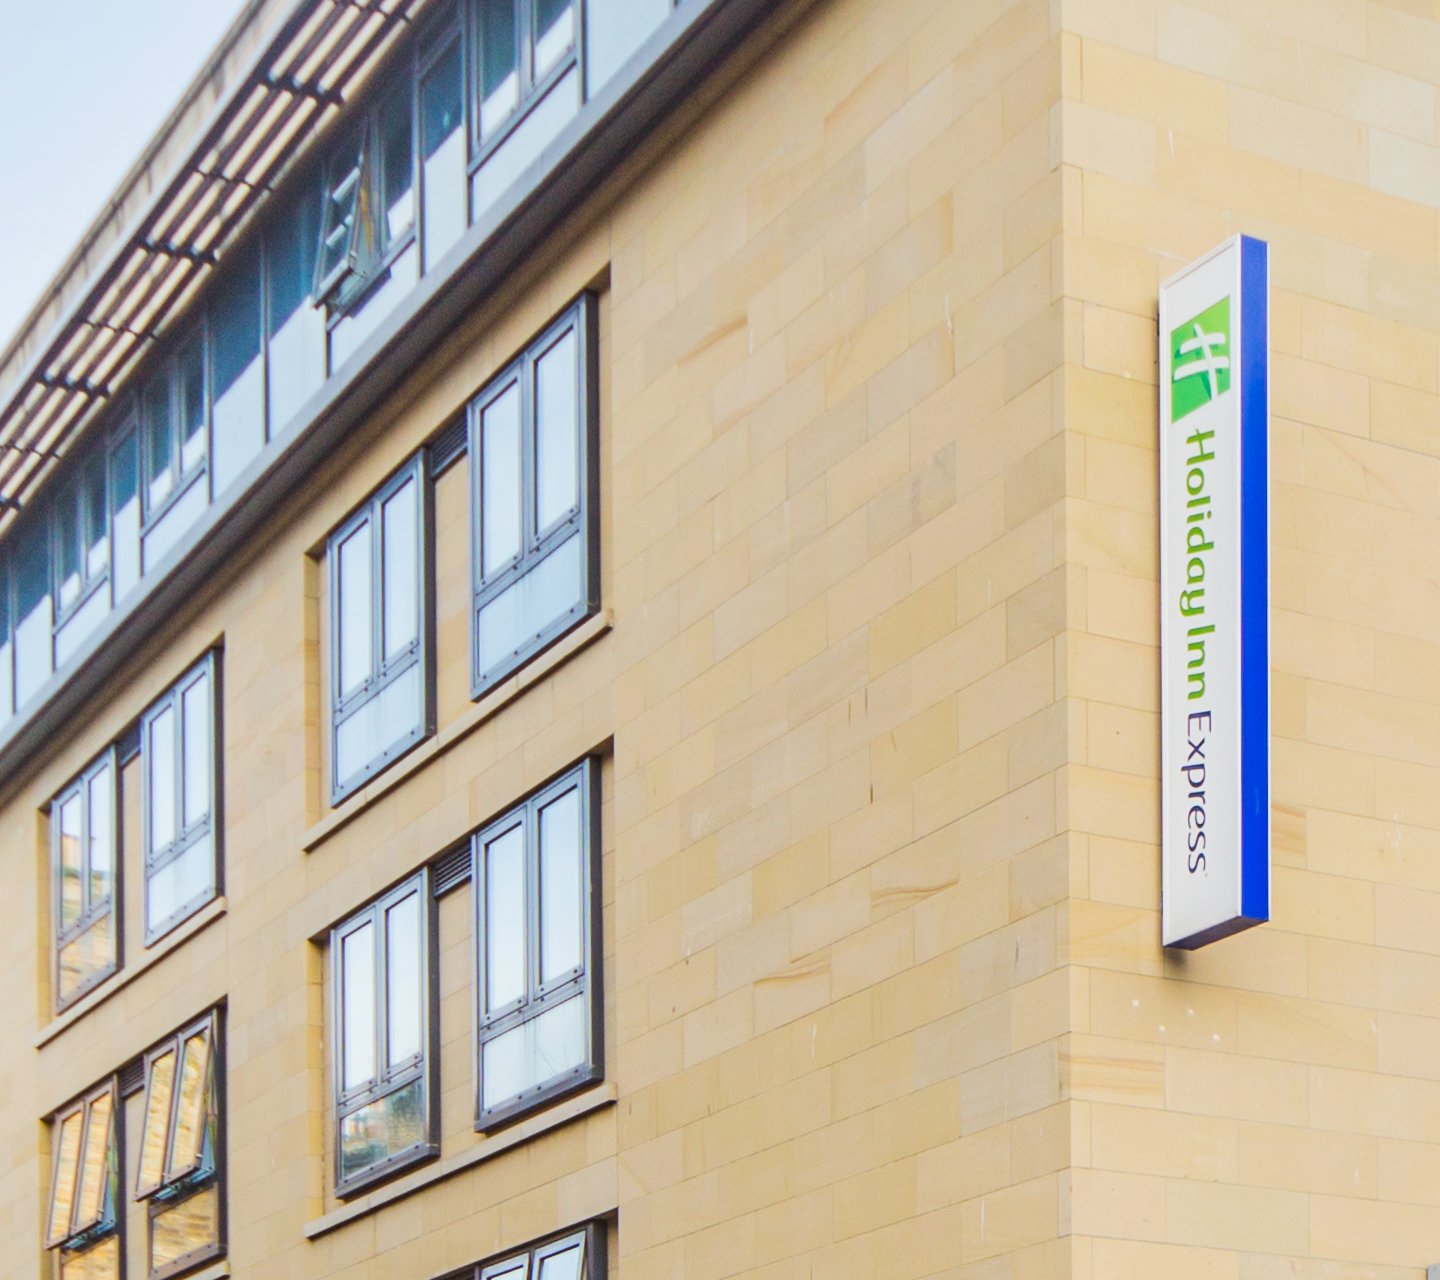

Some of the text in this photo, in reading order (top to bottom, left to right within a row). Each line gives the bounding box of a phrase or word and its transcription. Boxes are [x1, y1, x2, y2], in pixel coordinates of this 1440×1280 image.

[1179, 428, 1216, 875] Holiday Inn Express
